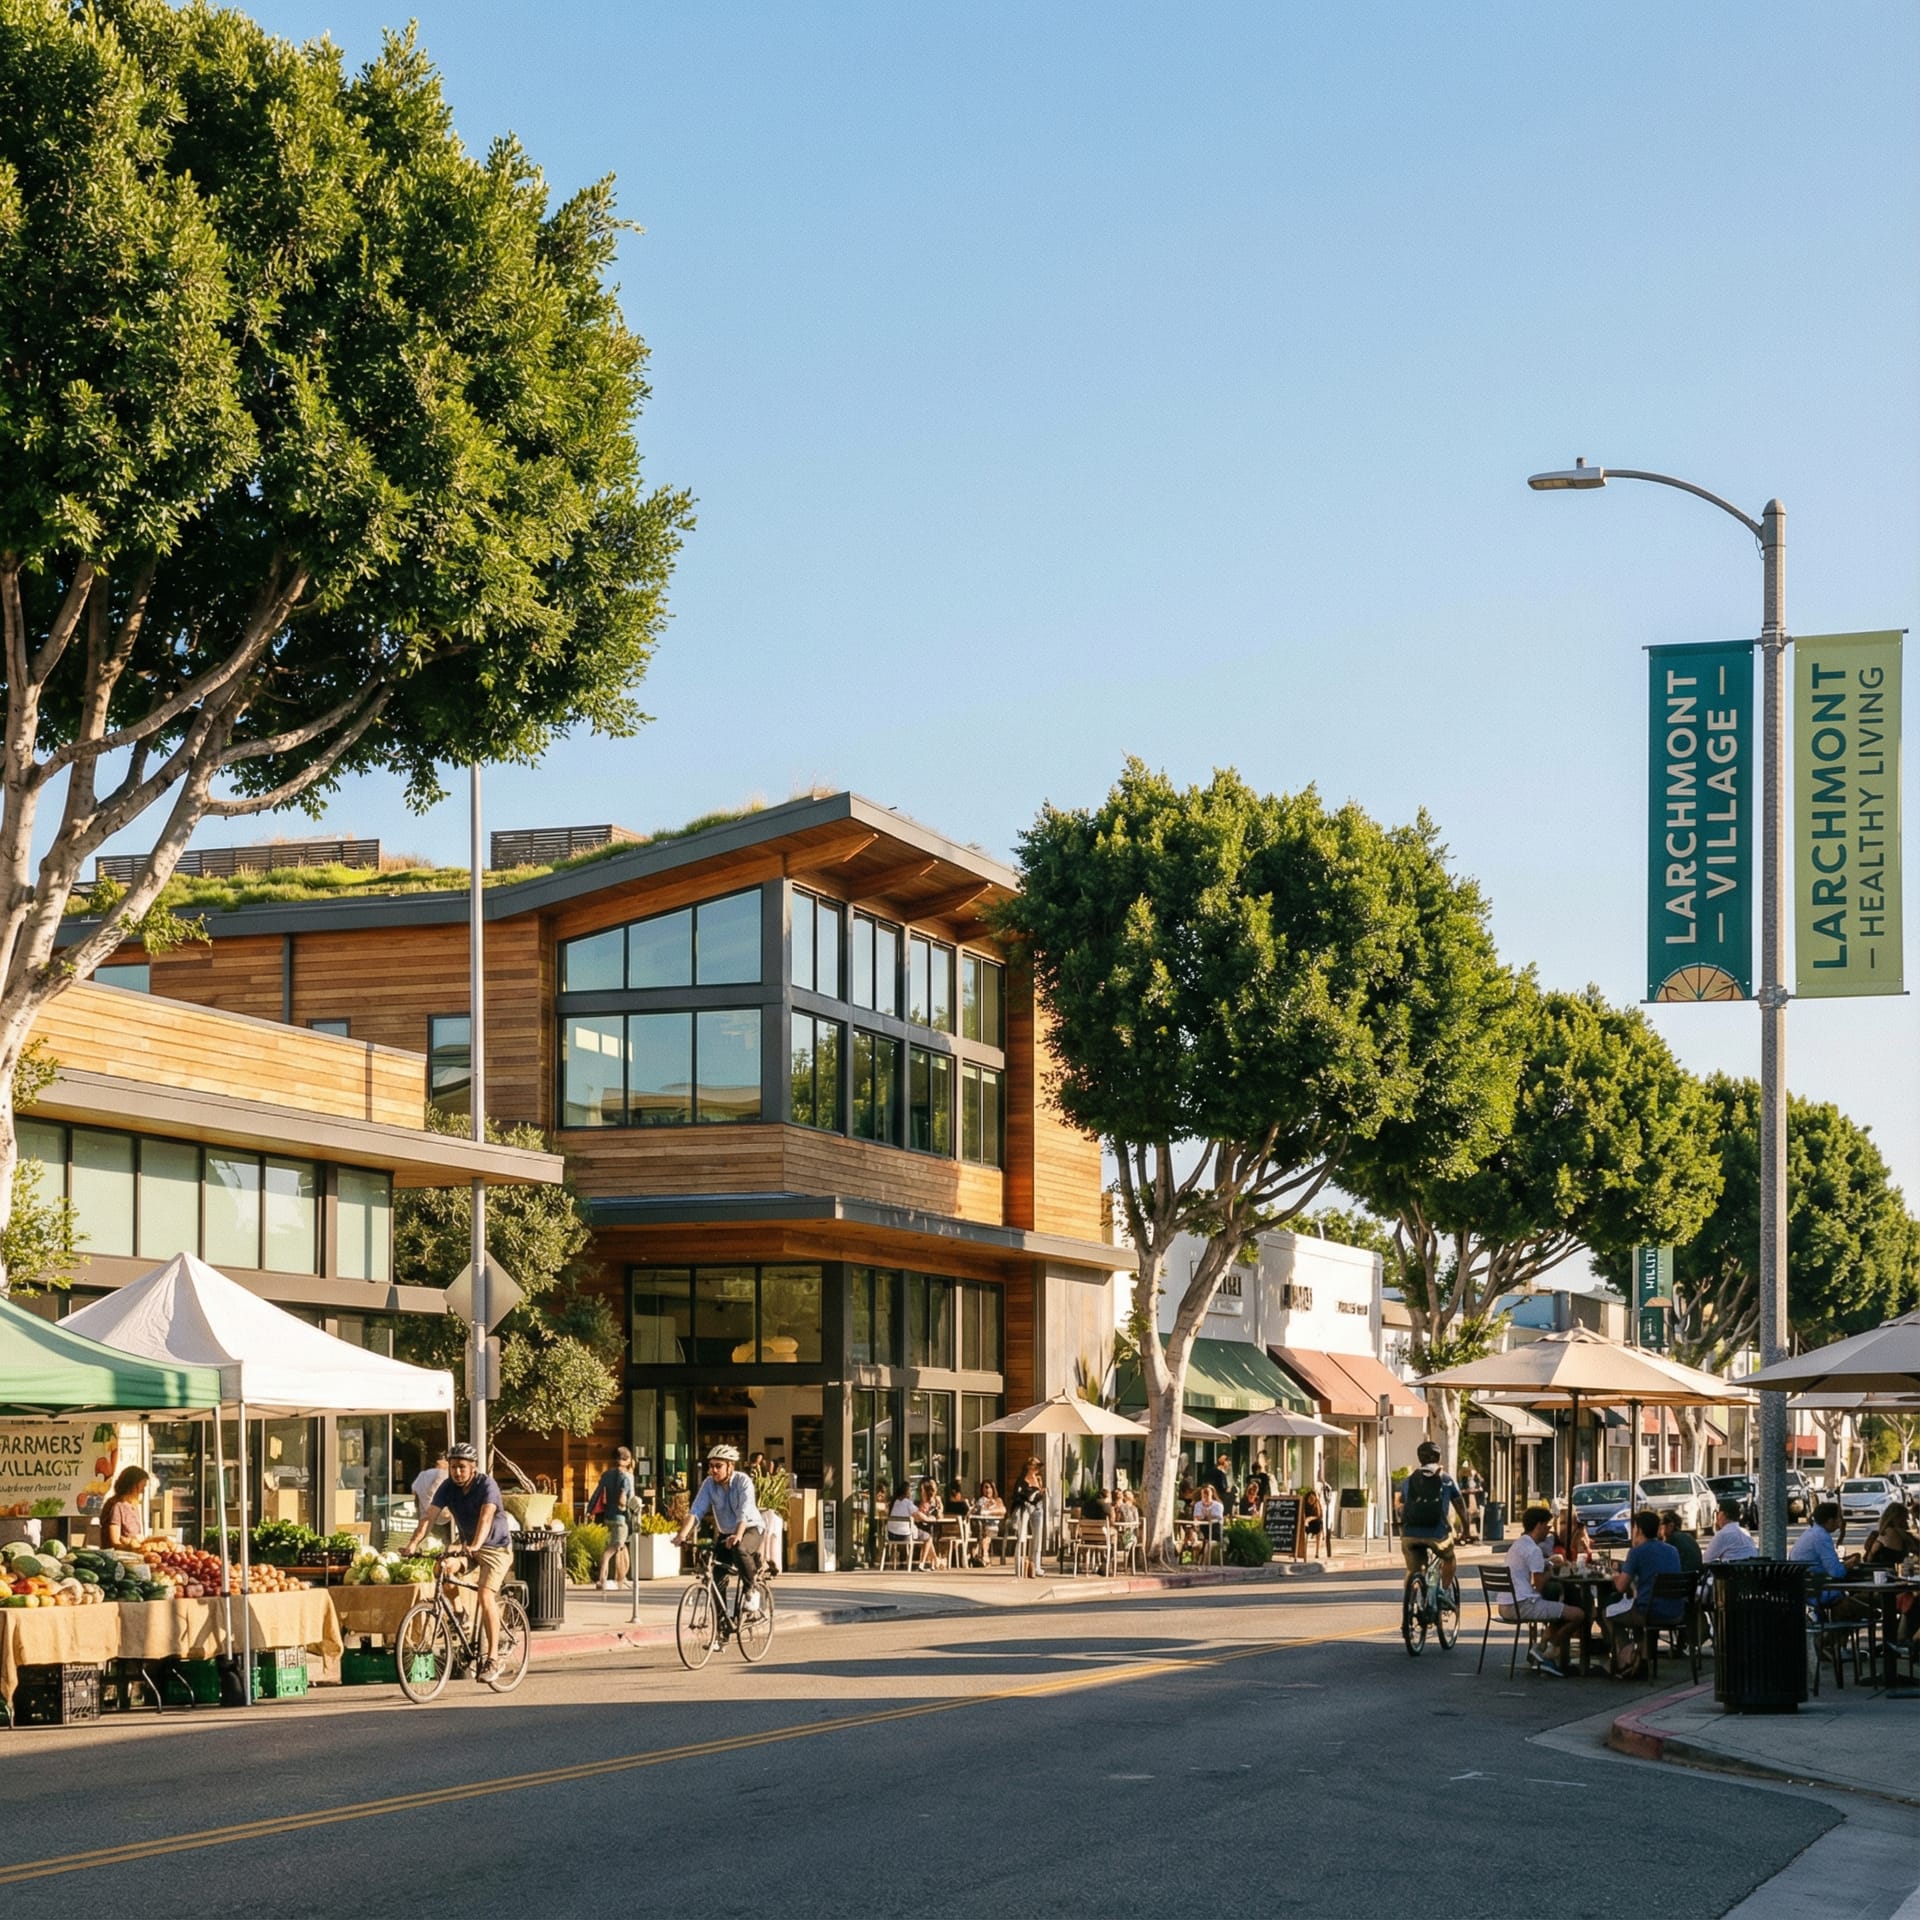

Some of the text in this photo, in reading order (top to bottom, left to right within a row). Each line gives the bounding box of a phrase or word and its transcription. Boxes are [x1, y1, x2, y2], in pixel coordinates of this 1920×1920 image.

[1665, 670, 1698, 944] LARCHMONT
[1706, 709, 1738, 899] VILLAGE
[1811, 663, 1848, 969] LARCHMONT
[1859, 666, 1885, 937] HEALTHY LIVING
